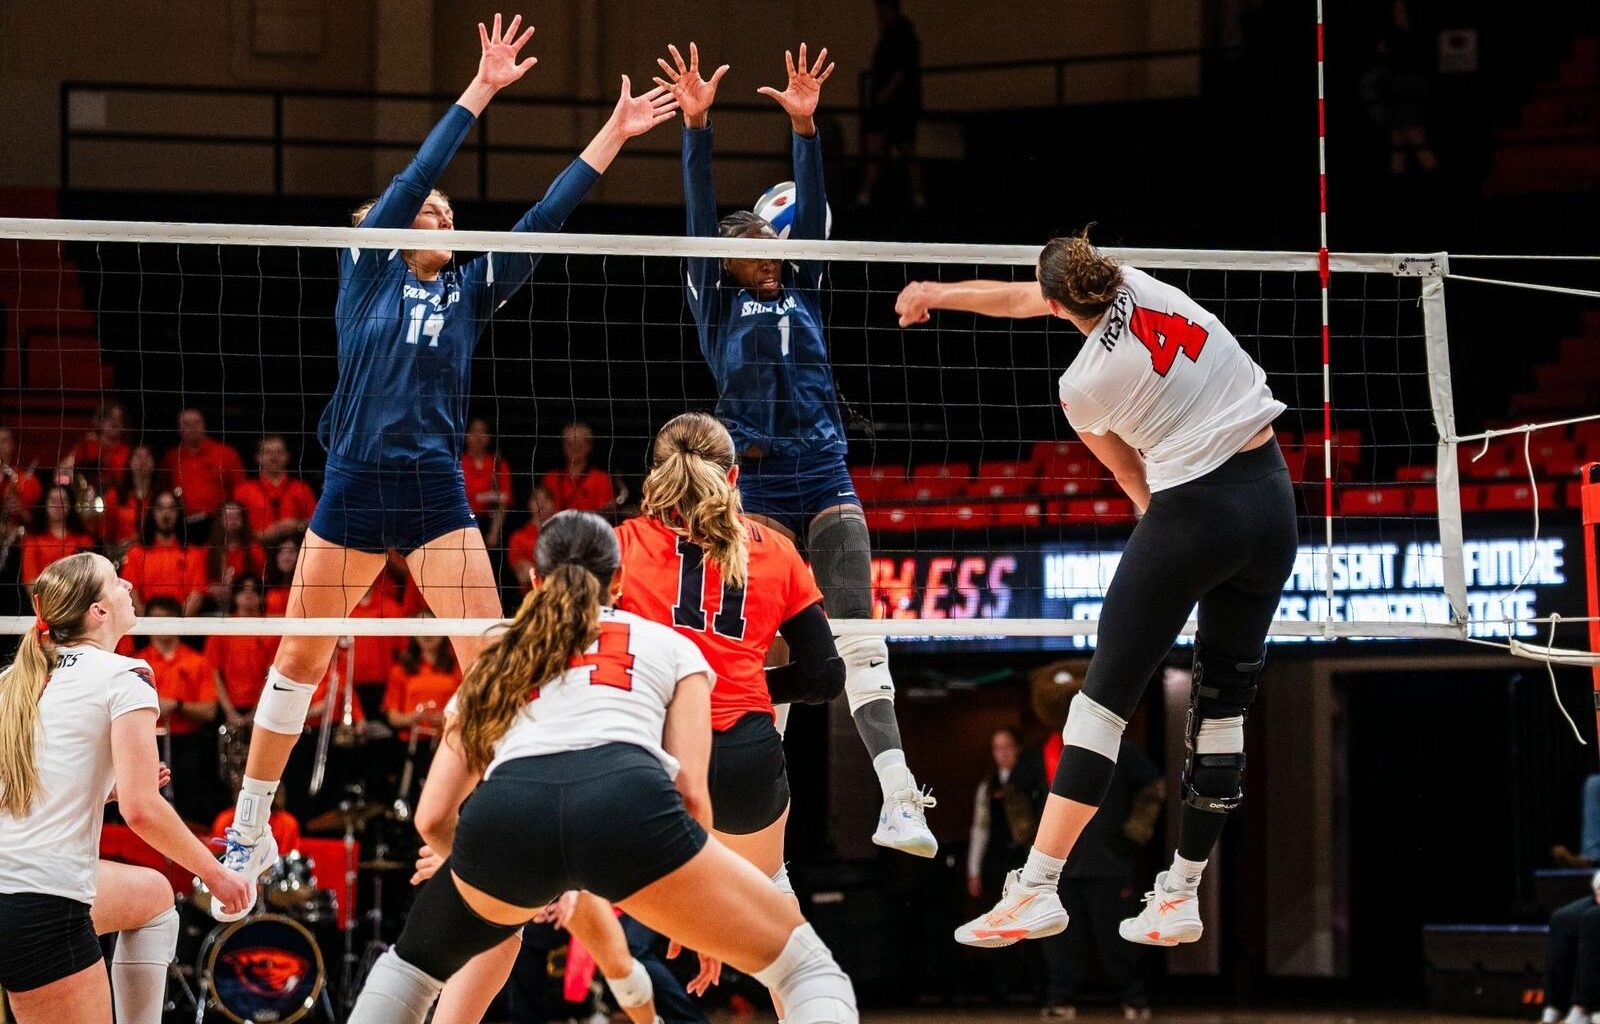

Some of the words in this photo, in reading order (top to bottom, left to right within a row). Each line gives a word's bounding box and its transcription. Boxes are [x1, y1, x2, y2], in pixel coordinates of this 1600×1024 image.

[406, 303, 445, 347] 14
[777, 315, 790, 357] 1
[1129, 304, 1209, 378] 4
[1463, 537, 1566, 586] FUTURE
[672, 535, 748, 642] 11
